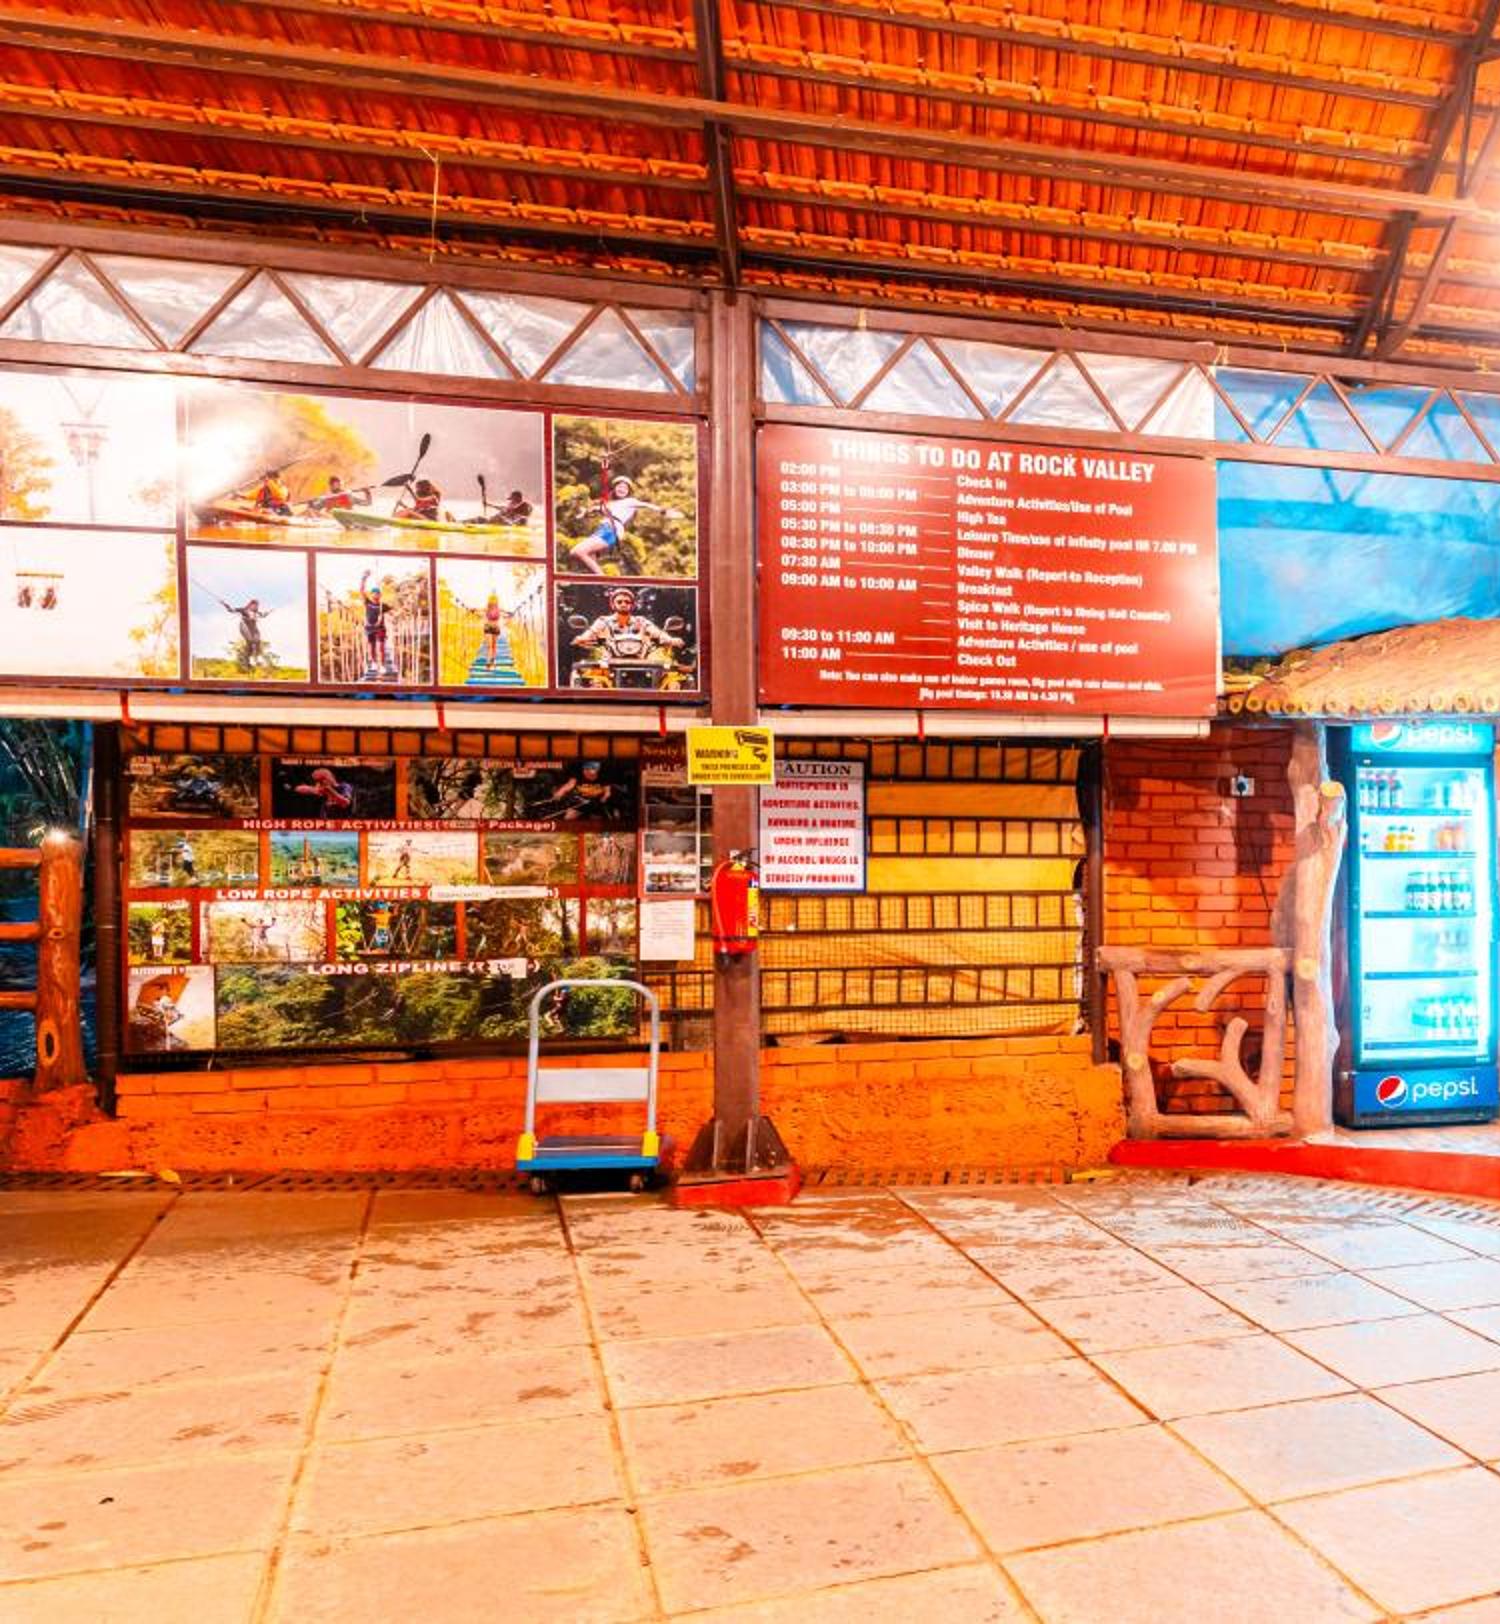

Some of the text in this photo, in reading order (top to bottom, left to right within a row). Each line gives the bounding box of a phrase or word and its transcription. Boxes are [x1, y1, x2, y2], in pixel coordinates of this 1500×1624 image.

[830, 438, 1155, 483] THINGS TO DO AT ROCK VALLEY
[780, 461, 817, 476] 02:00
[820, 464, 841, 478] PM
[957, 475, 993, 489] Check
[780, 480, 817, 495] 03:00
[820, 483, 841, 496] PM
[844, 485, 857, 497] to
[897, 488, 918, 502] PM
[957, 493, 1014, 509] Adventure
[1095, 502, 1107, 514] of
[1109, 503, 1133, 517] Pool
[780, 499, 1007, 527] 05:00 PM High Tea
[780, 517, 818, 531] 05:30
[820, 520, 841, 533] PM
[844, 521, 857, 534] to
[897, 525, 918, 538] PM
[957, 529, 998, 544] Leisure
[1054, 535, 1066, 547] of
[1109, 539, 1133, 552] pool
[1180, 543, 1197, 555] PM
[820, 538, 841, 551] PM
[844, 540, 857, 552] to
[860, 541, 895, 554] 10:00
[897, 543, 918, 556] PM
[957, 546, 996, 561] Dinner
[781, 554, 818, 568] 07:30
[820, 556, 841, 570] AM
[957, 563, 992, 580] Valley
[995, 565, 1023, 580] Walk
[1084, 571, 1144, 588] Reception)
[781, 573, 1013, 597] 09:00 AM to 10:00 AM Breakfast
[957, 600, 989, 615] Spice
[992, 601, 1021, 615] Walk
[957, 618, 1087, 636] Visit to Heritage House
[781, 627, 818, 642] 09:30
[820, 630, 834, 642] to
[837, 630, 872, 644] 11:00
[874, 631, 895, 645] AM
[957, 635, 1014, 649] Adventure
[1017, 637, 1069, 652] Activities
[1079, 642, 1098, 653] use
[1100, 642, 1113, 654] of
[1115, 642, 1139, 656] pool
[782, 646, 1017, 667] 11:00 AM Check Out
[776, 781, 837, 791] PARTICIPATION
[763, 799, 810, 809] ADVENTURE
[243, 819, 285, 830] HIGH
[291, 819, 334, 830] ROPE
[488, 817, 557, 831] Package)
[774, 837, 802, 846] UNDER
[216, 887, 257, 900] LOW
[263, 887, 313, 900] ROPE
[319, 886, 424, 900] ACTIVITIES
[307, 962, 369, 975] LONG
[375, 960, 463, 974] ZIPLINE
[1412, 1075, 1479, 1104] pepsi
